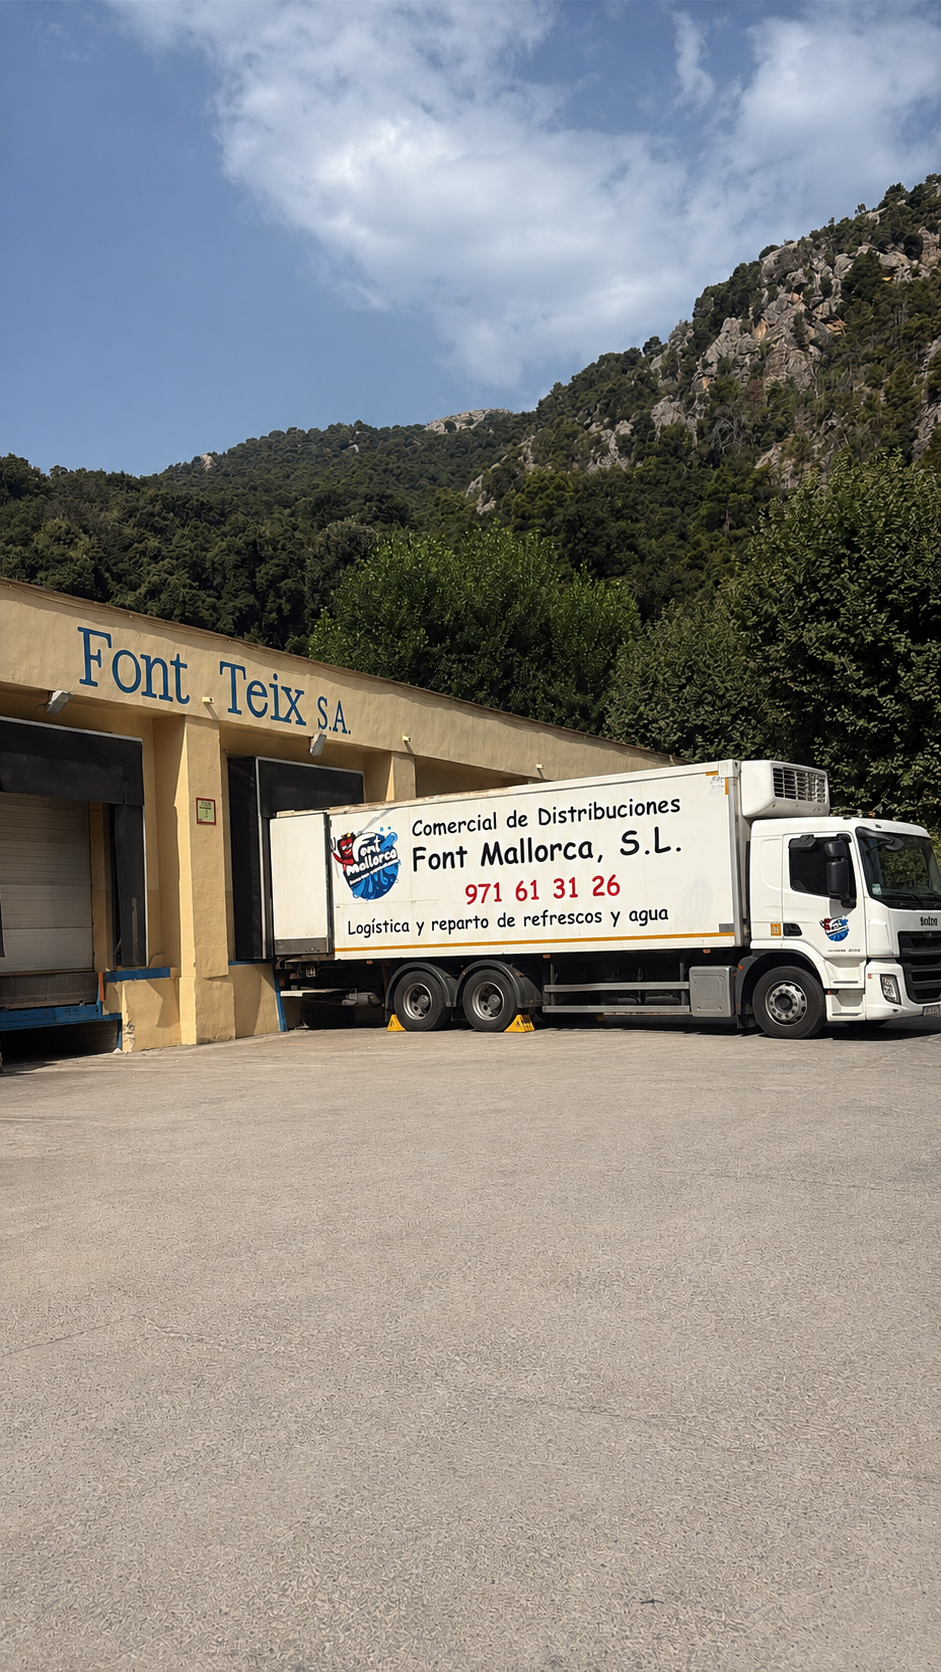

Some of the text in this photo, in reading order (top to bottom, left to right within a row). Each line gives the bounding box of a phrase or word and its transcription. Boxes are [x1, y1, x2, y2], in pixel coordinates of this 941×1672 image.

[77, 626, 351, 735] Font Teix S.A.
[412, 798, 681, 837] Comercial de Distribuciones
[412, 846, 468, 873] Font
[480, 837, 604, 867] Mallorca,
[619, 826, 682, 856] S.L.
[464, 874, 621, 906] 971 61 31 26
[347, 908, 669, 939] Logística y reparto de refrescos y agua
